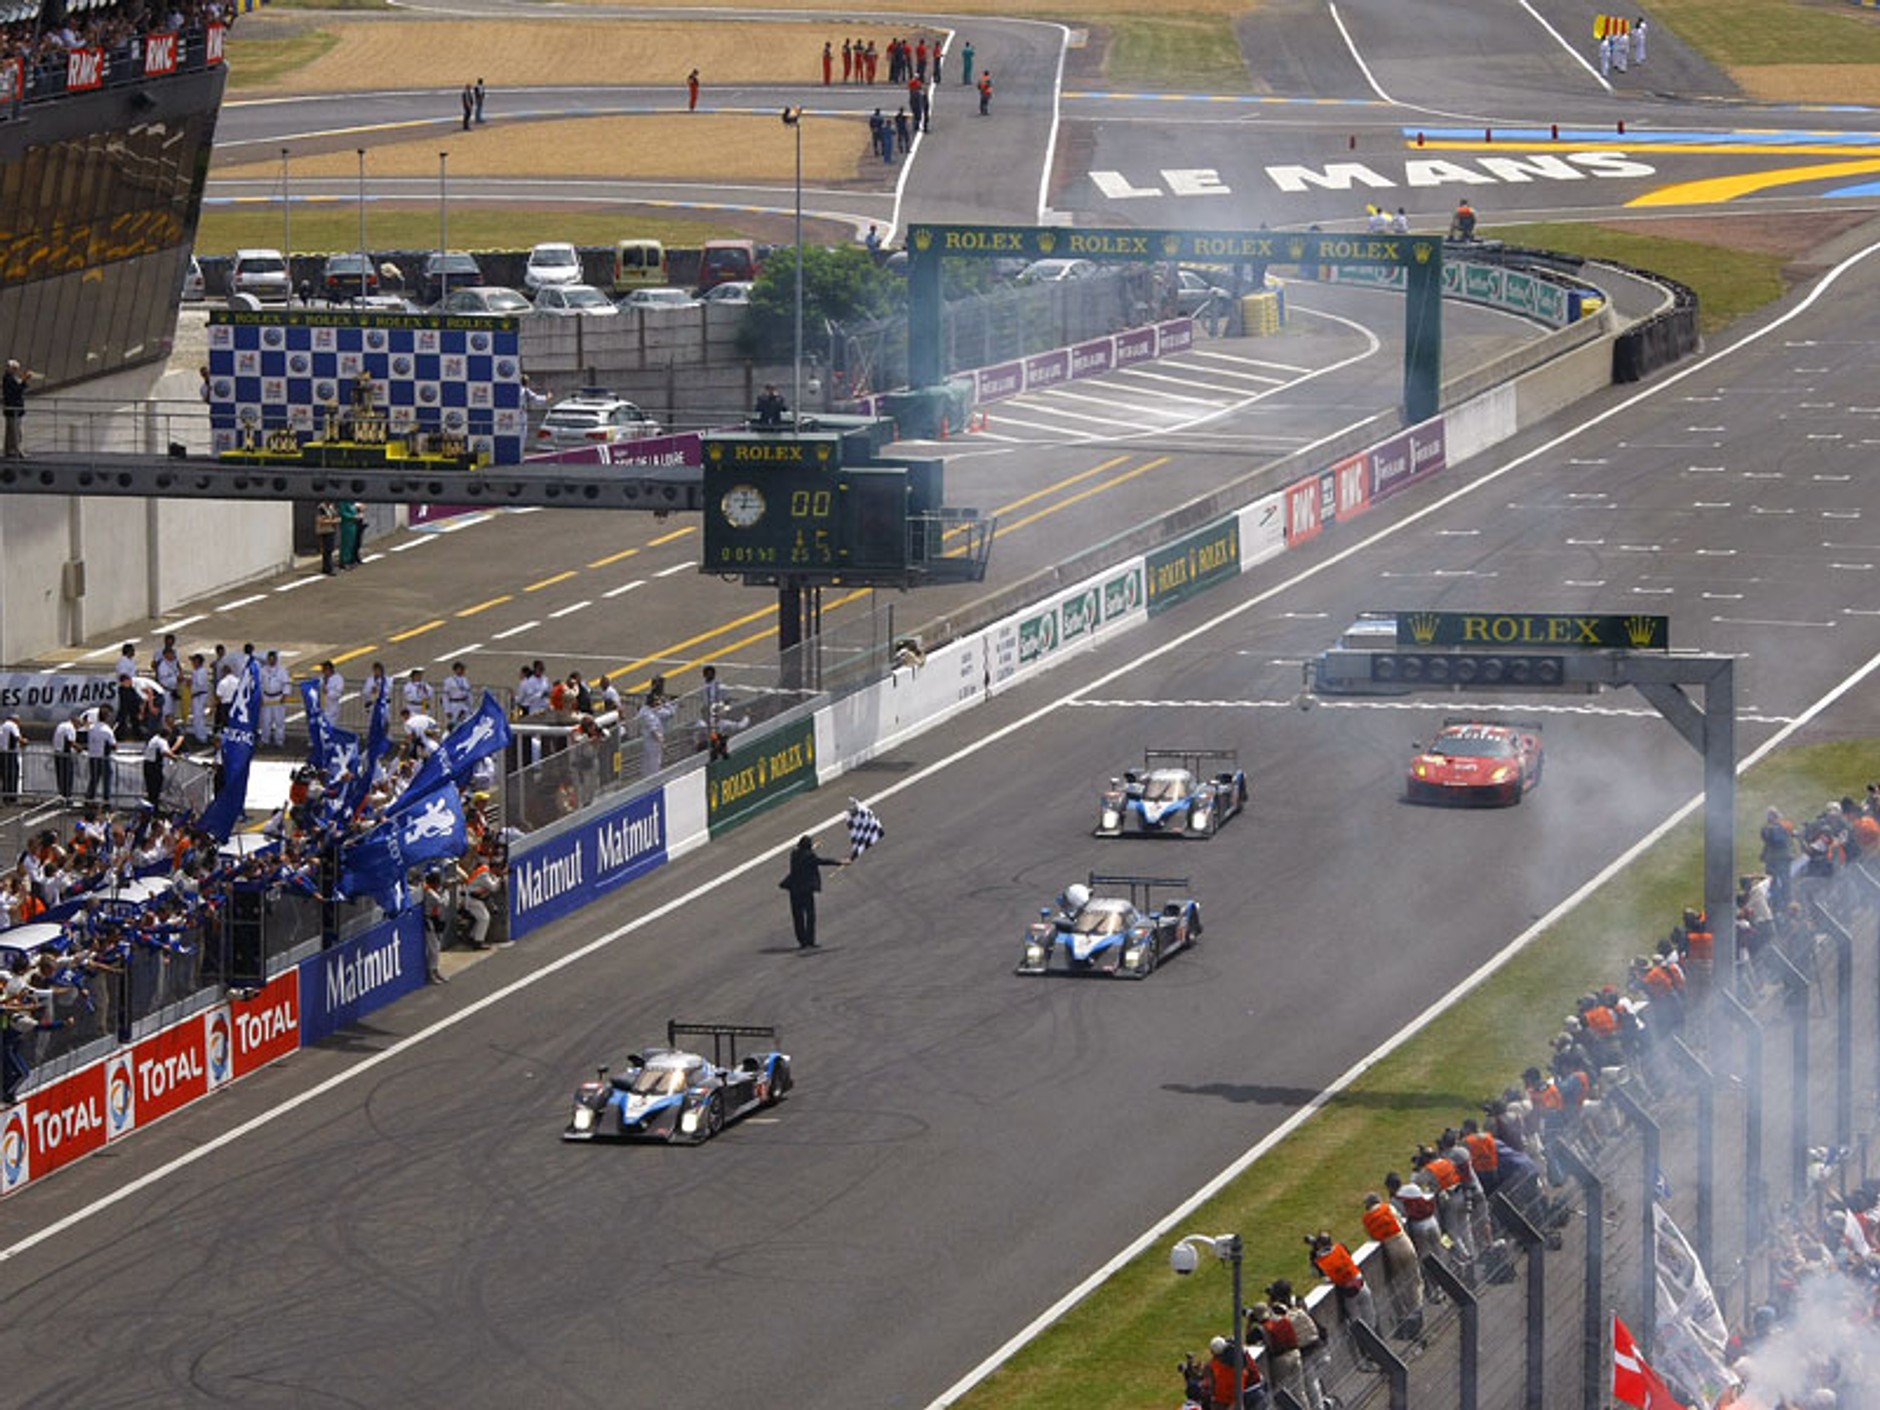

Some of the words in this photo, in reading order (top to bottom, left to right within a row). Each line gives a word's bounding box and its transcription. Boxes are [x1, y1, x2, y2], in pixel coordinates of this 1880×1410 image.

[67, 52, 100, 86] RMC
[145, 37, 173, 72] RMC
[1088, 168, 1232, 199] LE
[1265, 151, 1657, 192] MANS
[946, 232, 1023, 249] ROLEX
[1071, 235, 1148, 254] ROLEX
[1194, 237, 1273, 256] ROLEX
[1319, 241, 1400, 260] ROLEX
[235, 314, 281, 324] ROLEX
[306, 315, 350, 325] ROLEX
[376, 317, 423, 327] ROLEX
[447, 319, 493, 329] ROLEX
[735, 445, 804, 460] ROLEX
[791, 491, 831, 516] 00
[1341, 461, 1362, 511] RMC
[1292, 485, 1316, 537] RMC
[1158, 556, 1188, 593] ROLEX
[1199, 537, 1227, 572] ROLEX
[1463, 616, 1603, 644] ROLEX
[27, 686, 54, 706] DU
[58, 681, 118, 704] MANS
[721, 766, 756, 804] ROLEX
[769, 744, 803, 781] ROLEX
[515, 840, 583, 916] Matmut
[597, 802, 660, 875] Matmut
[326, 928, 402, 1014] Matmut
[235, 1001, 297, 1054] TOTAL
[139, 1047, 203, 1101] TOTAL
[33, 1097, 103, 1154] TOTAL
